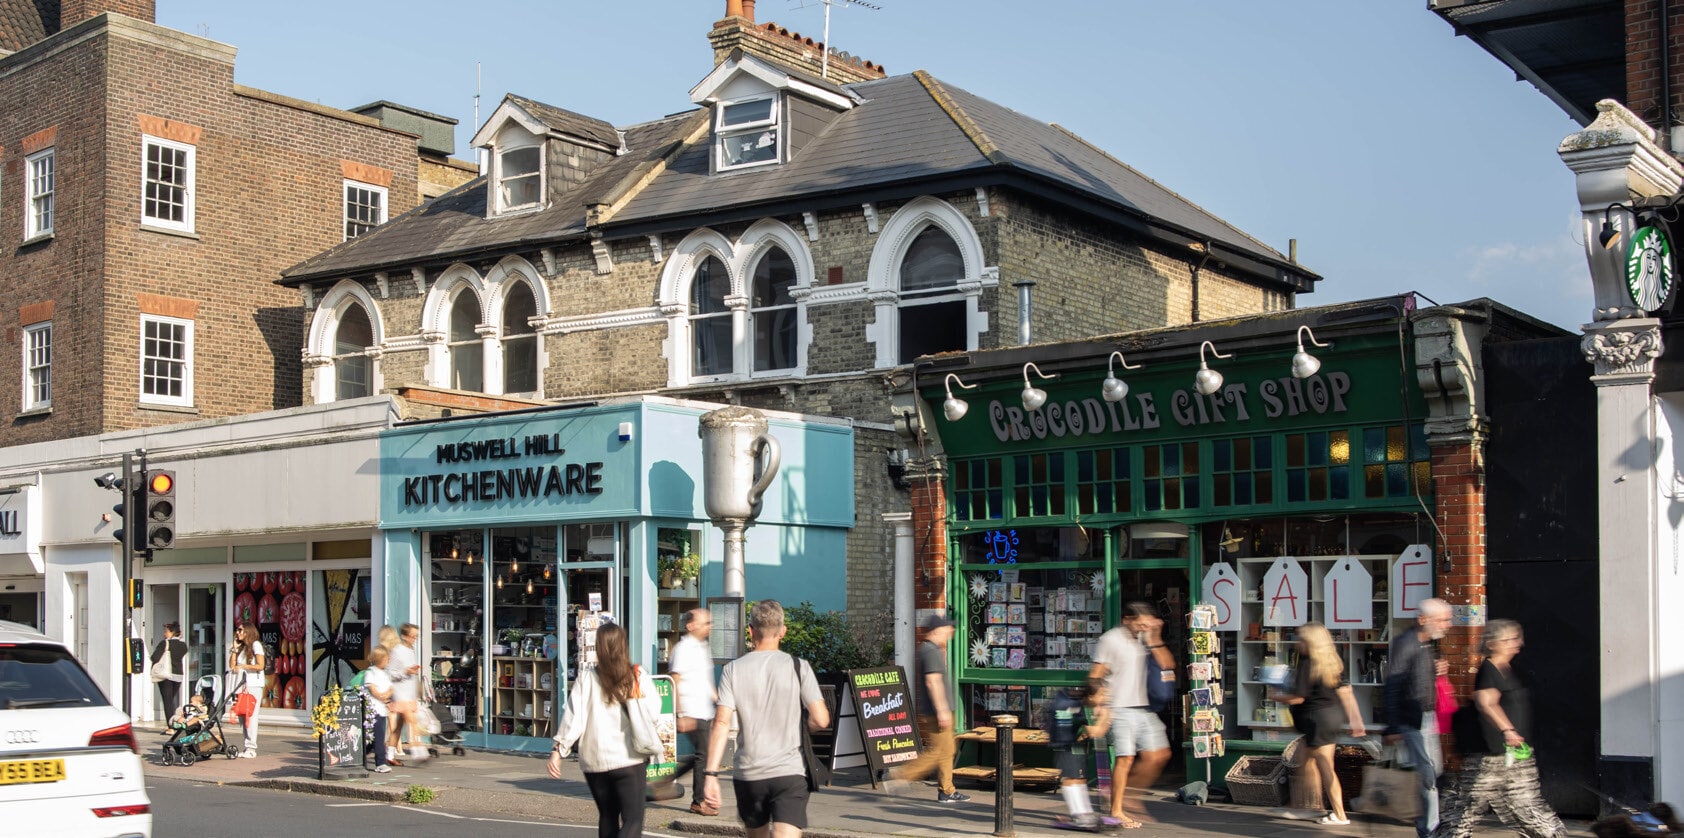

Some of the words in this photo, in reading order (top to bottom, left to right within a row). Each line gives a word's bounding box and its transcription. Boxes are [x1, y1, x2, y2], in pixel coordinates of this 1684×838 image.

[989, 392, 1160, 442] CROCODILE
[1171, 382, 1250, 426] GIFT
[1259, 371, 1350, 418] SHOP
[436, 437, 521, 464] MUSWELL
[524, 433, 565, 456] HILL
[405, 462, 603, 506] KITCHENWARE
[262, 632, 278, 643] M&S
[345, 632, 362, 644] M&S
[863, 692, 903, 719] Breakfast
